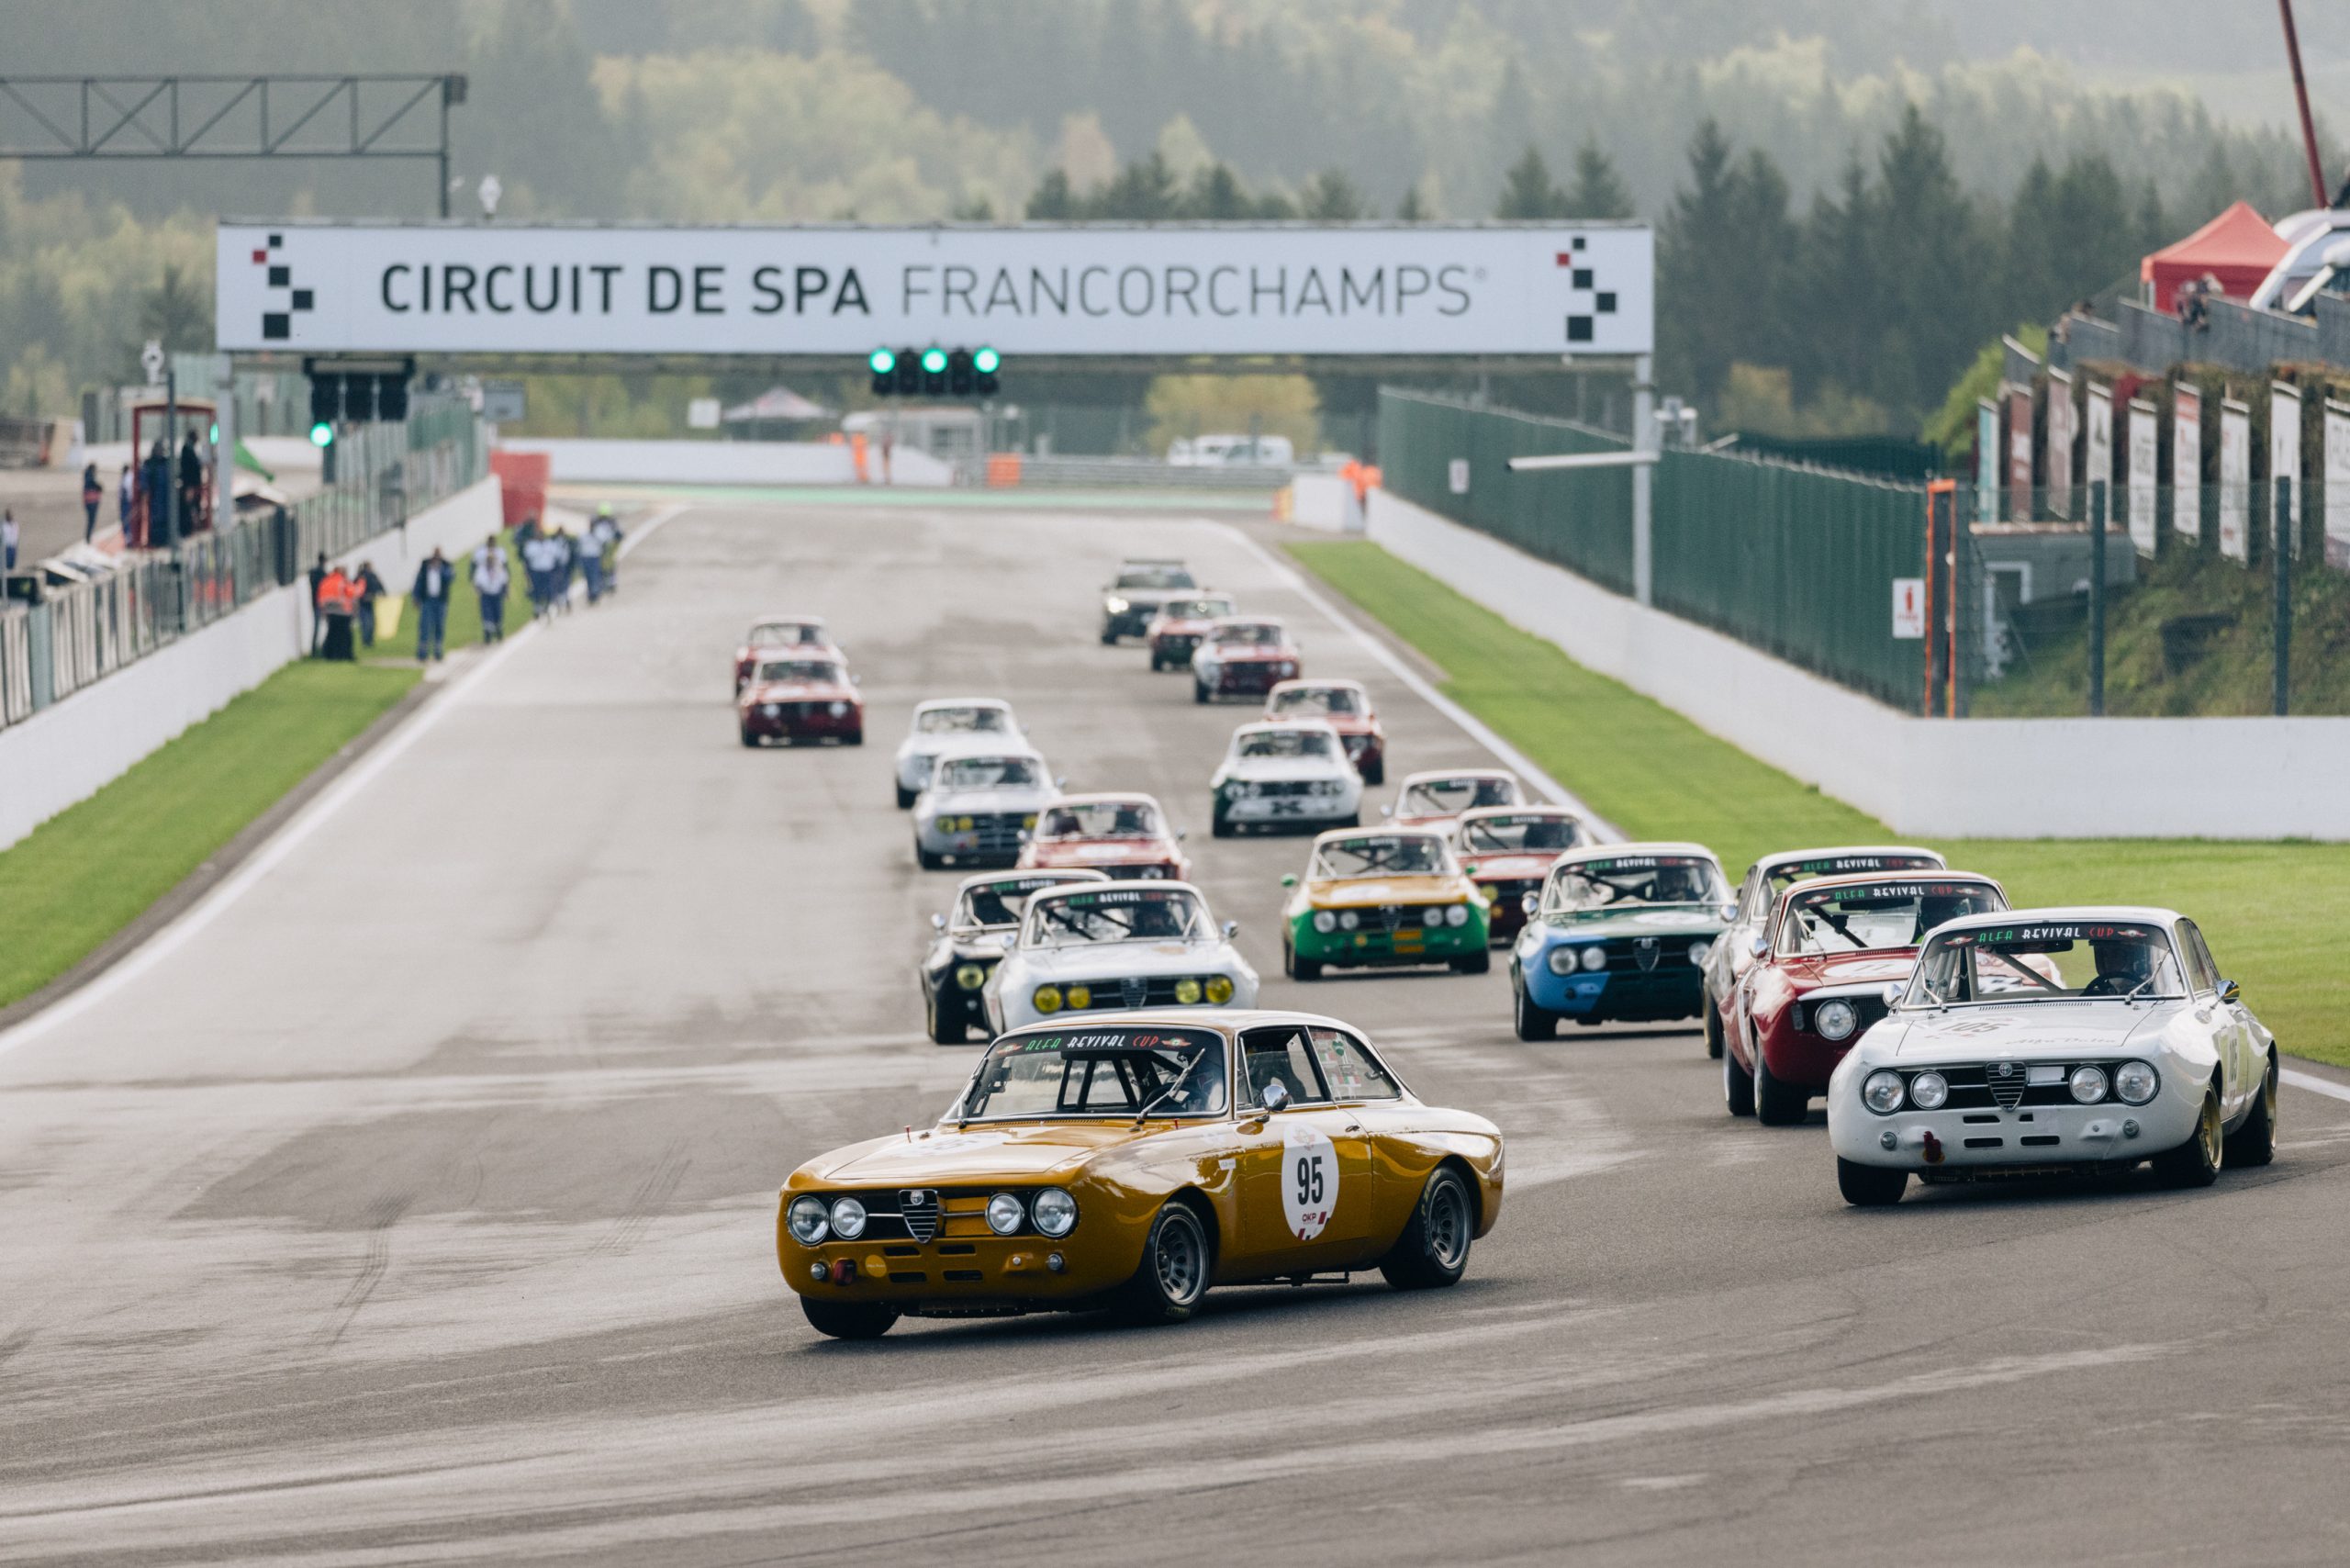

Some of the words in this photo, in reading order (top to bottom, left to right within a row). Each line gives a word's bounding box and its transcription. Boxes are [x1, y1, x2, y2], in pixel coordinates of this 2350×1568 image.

[380, 263, 624, 314] CIRCUIT
[647, 264, 725, 314] DE
[752, 264, 870, 315] SPA
[1836, 858, 1881, 869] REVIVAL
[1836, 890, 1865, 901] ALFA
[1873, 885, 1925, 897] REVIVAL
[1978, 930, 2013, 943] ALFA
[2021, 926, 2081, 940] REVIVAL
[2088, 927, 2115, 937] CUP
[1941, 1022, 2010, 1033] 105
[1025, 1037, 1062, 1051] ALFA
[1067, 1035, 1126, 1048] REVIVAL
[1132, 1035, 1159, 1047] CUP
[1297, 1156, 1324, 1205] 95
